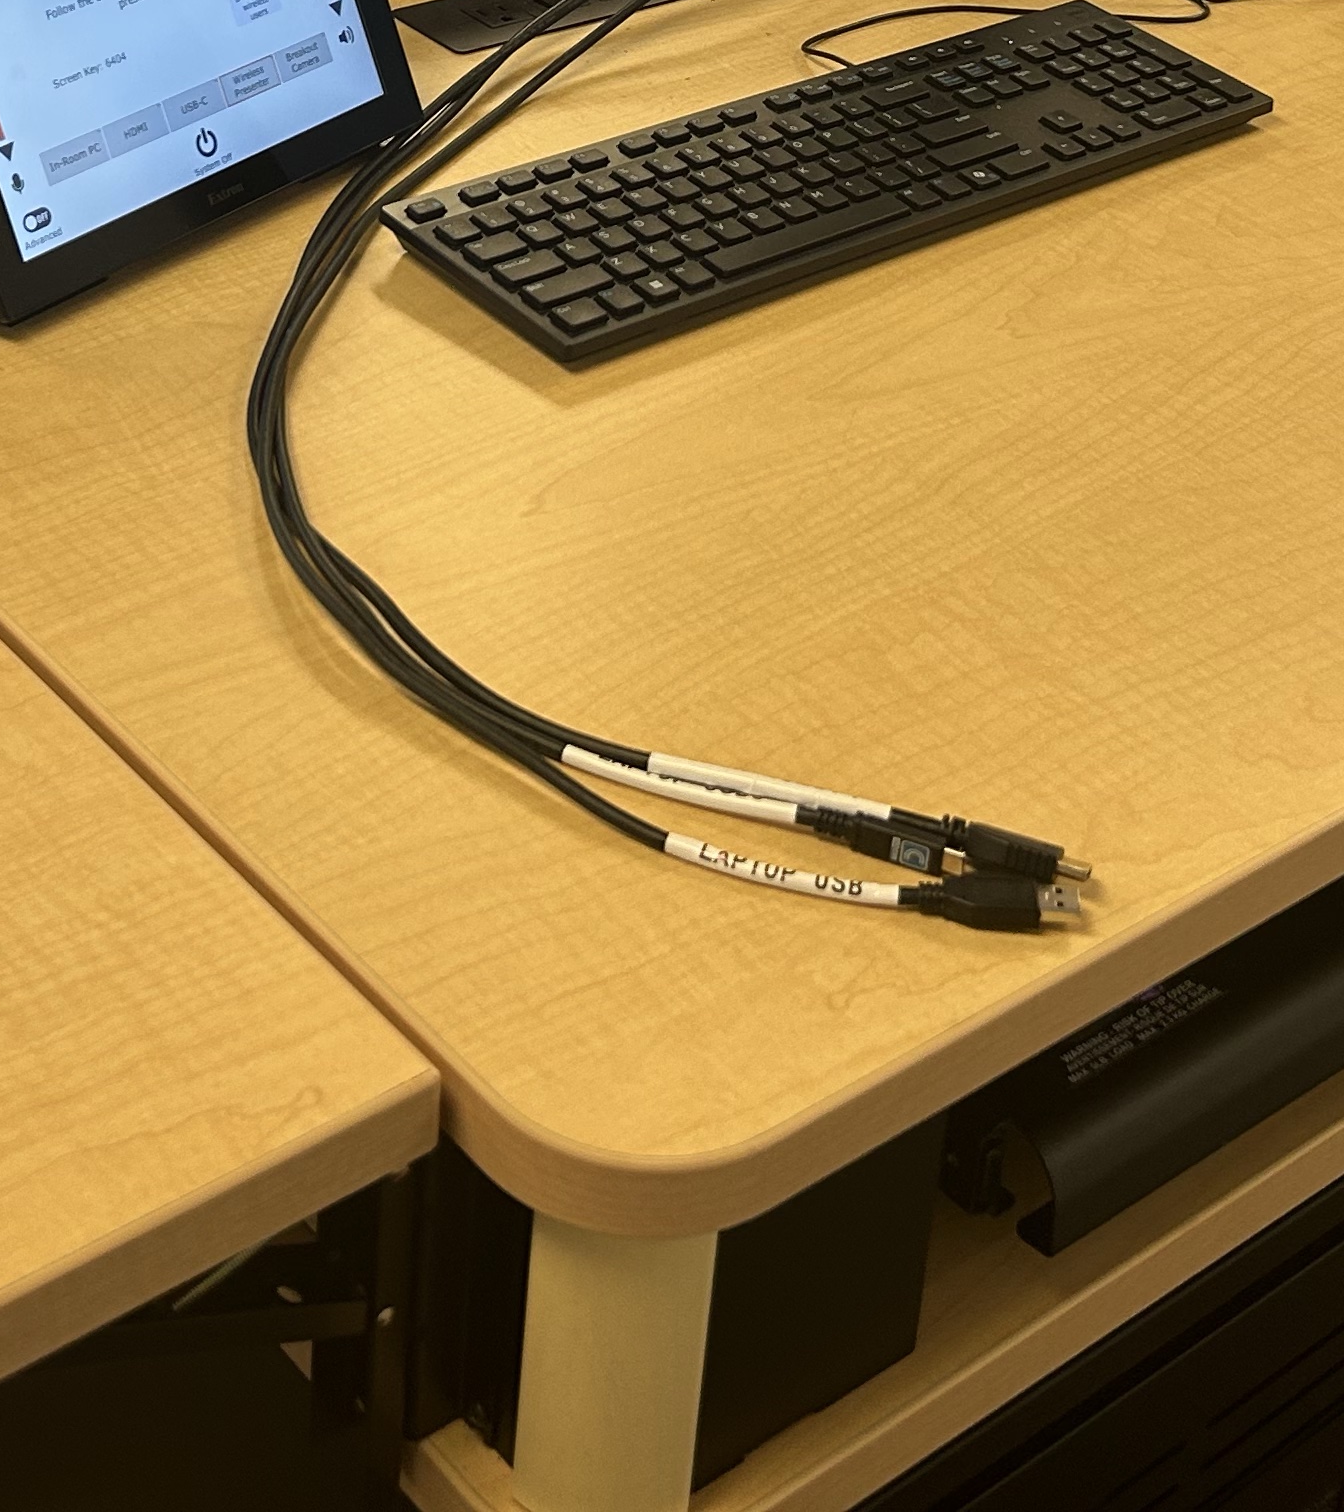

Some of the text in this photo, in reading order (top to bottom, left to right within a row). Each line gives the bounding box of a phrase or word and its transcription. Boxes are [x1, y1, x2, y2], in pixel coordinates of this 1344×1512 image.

[45, 3, 76, 21] Follow
[250, 8, 269, 21] users
[285, 42, 318, 62] Breakout
[52, 71, 83, 89] Screen
[105, 52, 127, 68] 6404
[291, 55, 320, 73] Camera
[233, 65, 265, 85] Wireless
[234, 77, 270, 98] Presenter
[181, 95, 208, 115] USB-C
[123, 121, 149, 140] HDMI
[49, 142, 102, 173] In-Room PC
[194, 158, 221, 177] System
[25, 227, 63, 250] Advanced
[698, 842, 864, 897] LAPTOP USB
